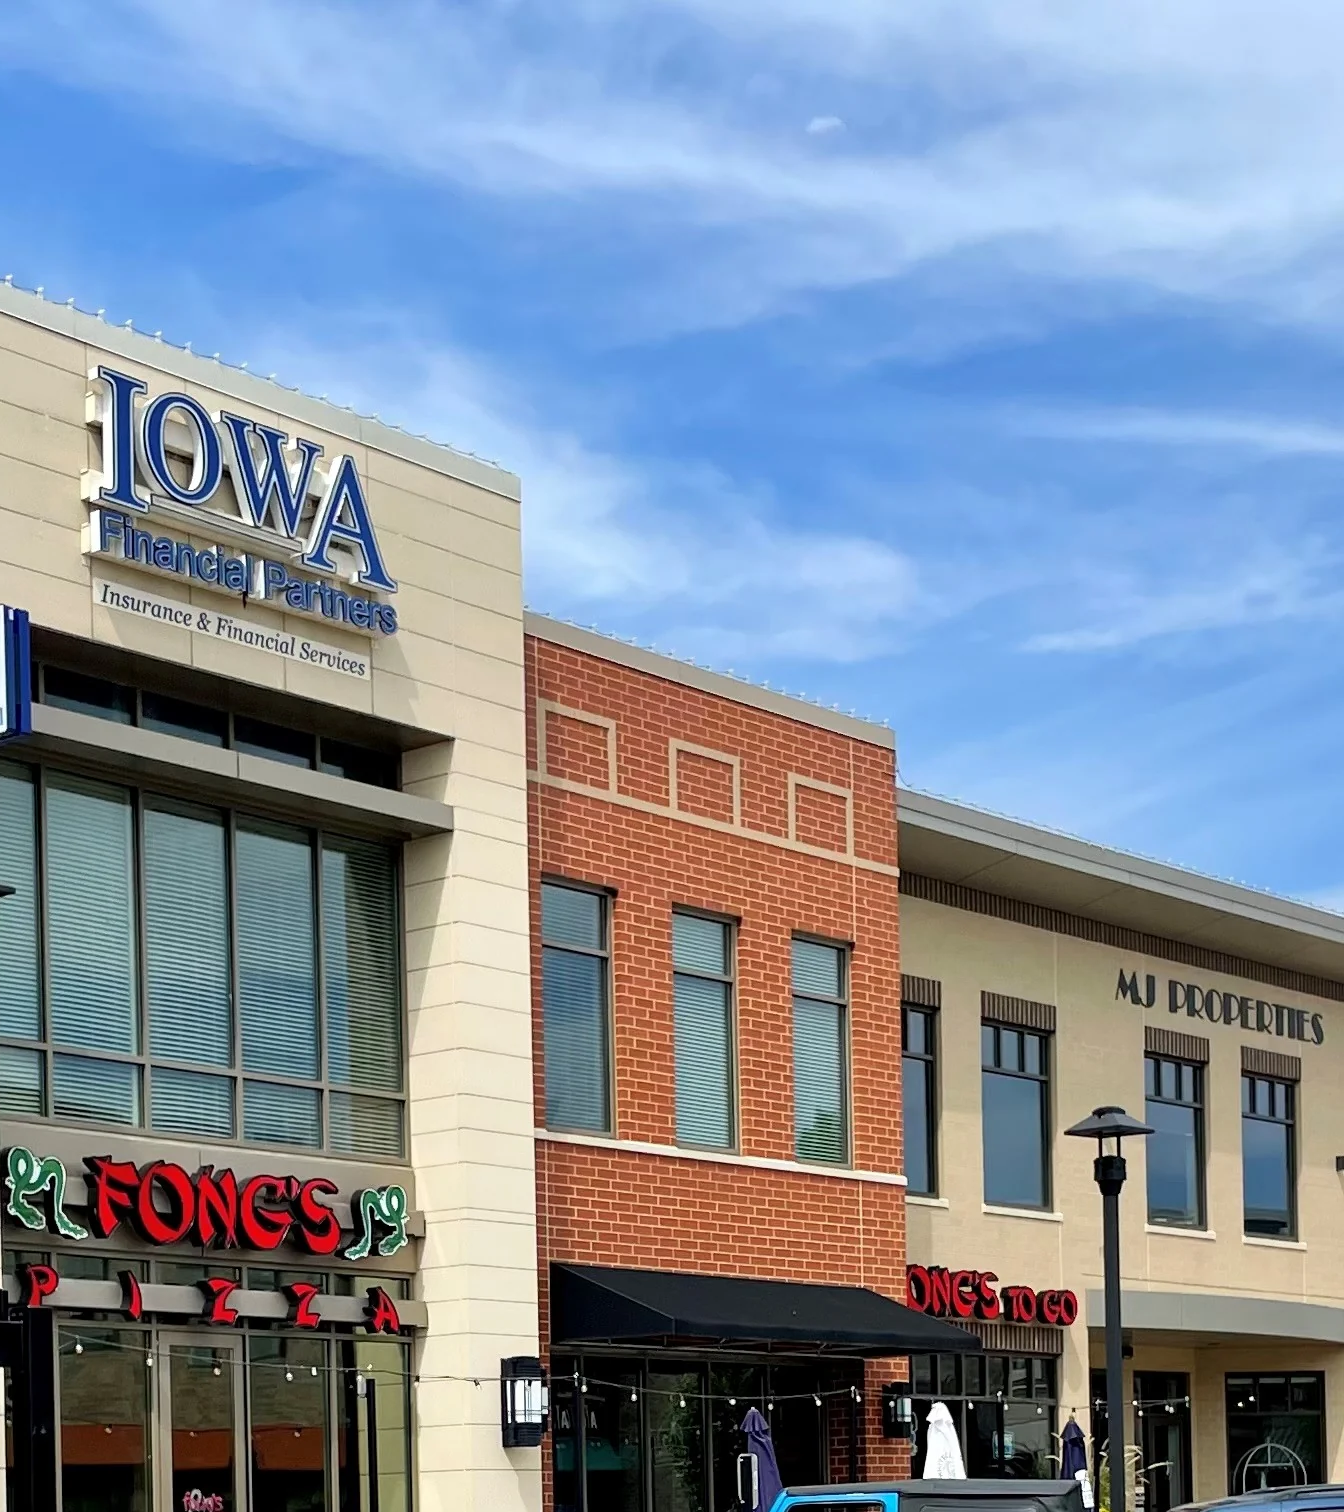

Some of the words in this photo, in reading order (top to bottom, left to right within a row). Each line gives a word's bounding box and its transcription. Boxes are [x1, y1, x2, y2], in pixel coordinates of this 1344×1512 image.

[96, 365, 398, 594] IOWA
[100, 509, 255, 595] Financial
[264, 559, 399, 635] Partners
[101, 583, 193, 627] Insurance
[197, 612, 212, 633] &
[215, 616, 296, 657] Financial
[299, 642, 366, 677] Services
[1115, 968, 1155, 1008] MJ
[1168, 979, 1324, 1045] PROPERTIES
[86, 1154, 341, 1255] FONG'S
[23, 1263, 400, 1335] PIZZA
[906, 1263, 1000, 1320] ONG'S
[1001, 1286, 1036, 1323] TO
[1036, 1290, 1077, 1326] GO
